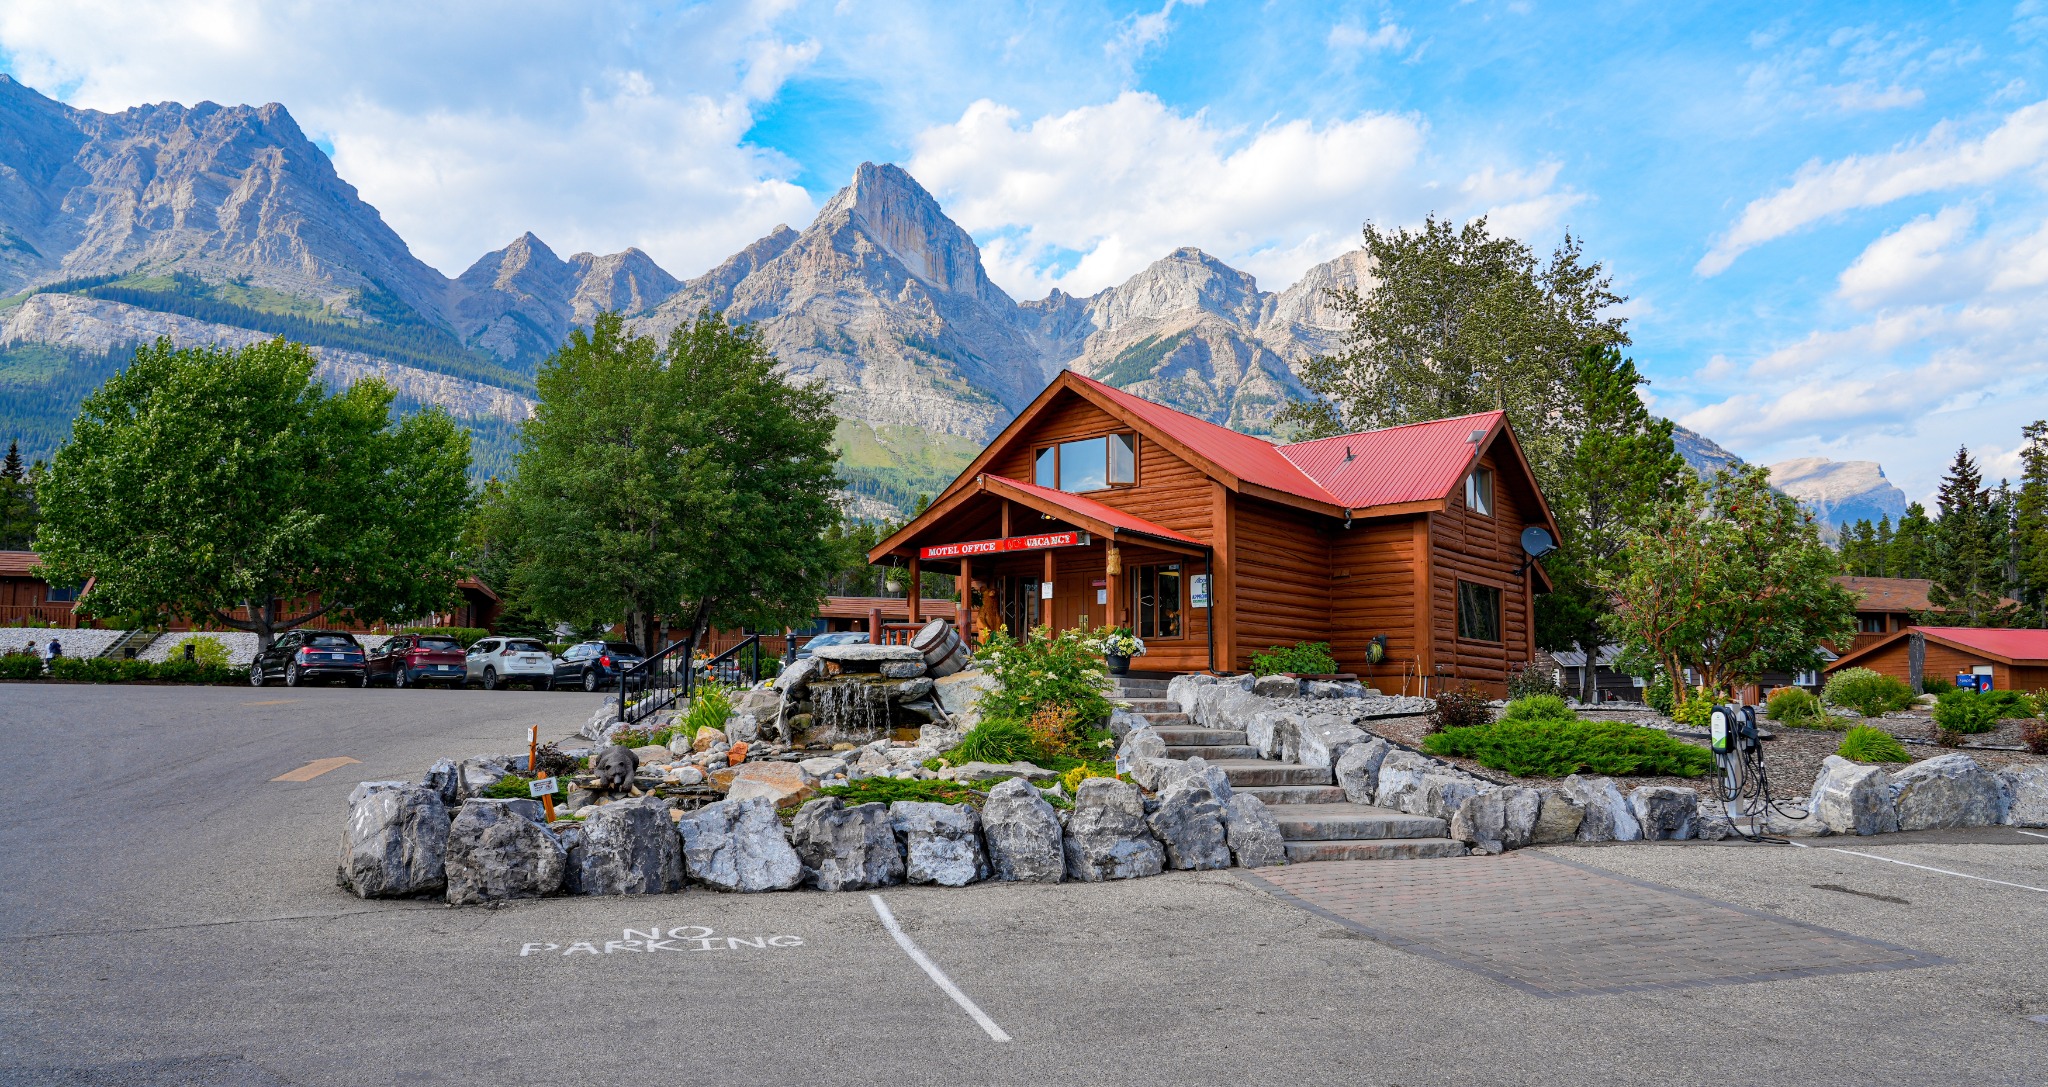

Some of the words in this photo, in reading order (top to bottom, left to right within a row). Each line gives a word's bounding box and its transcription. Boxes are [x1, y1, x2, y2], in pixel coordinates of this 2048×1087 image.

[1025, 535, 1071, 547] VACANCY
[928, 545, 959, 557] MOTEL
[962, 542, 996, 553] OFFICE
[623, 926, 714, 940] NO
[519, 935, 803, 957] PARKING
